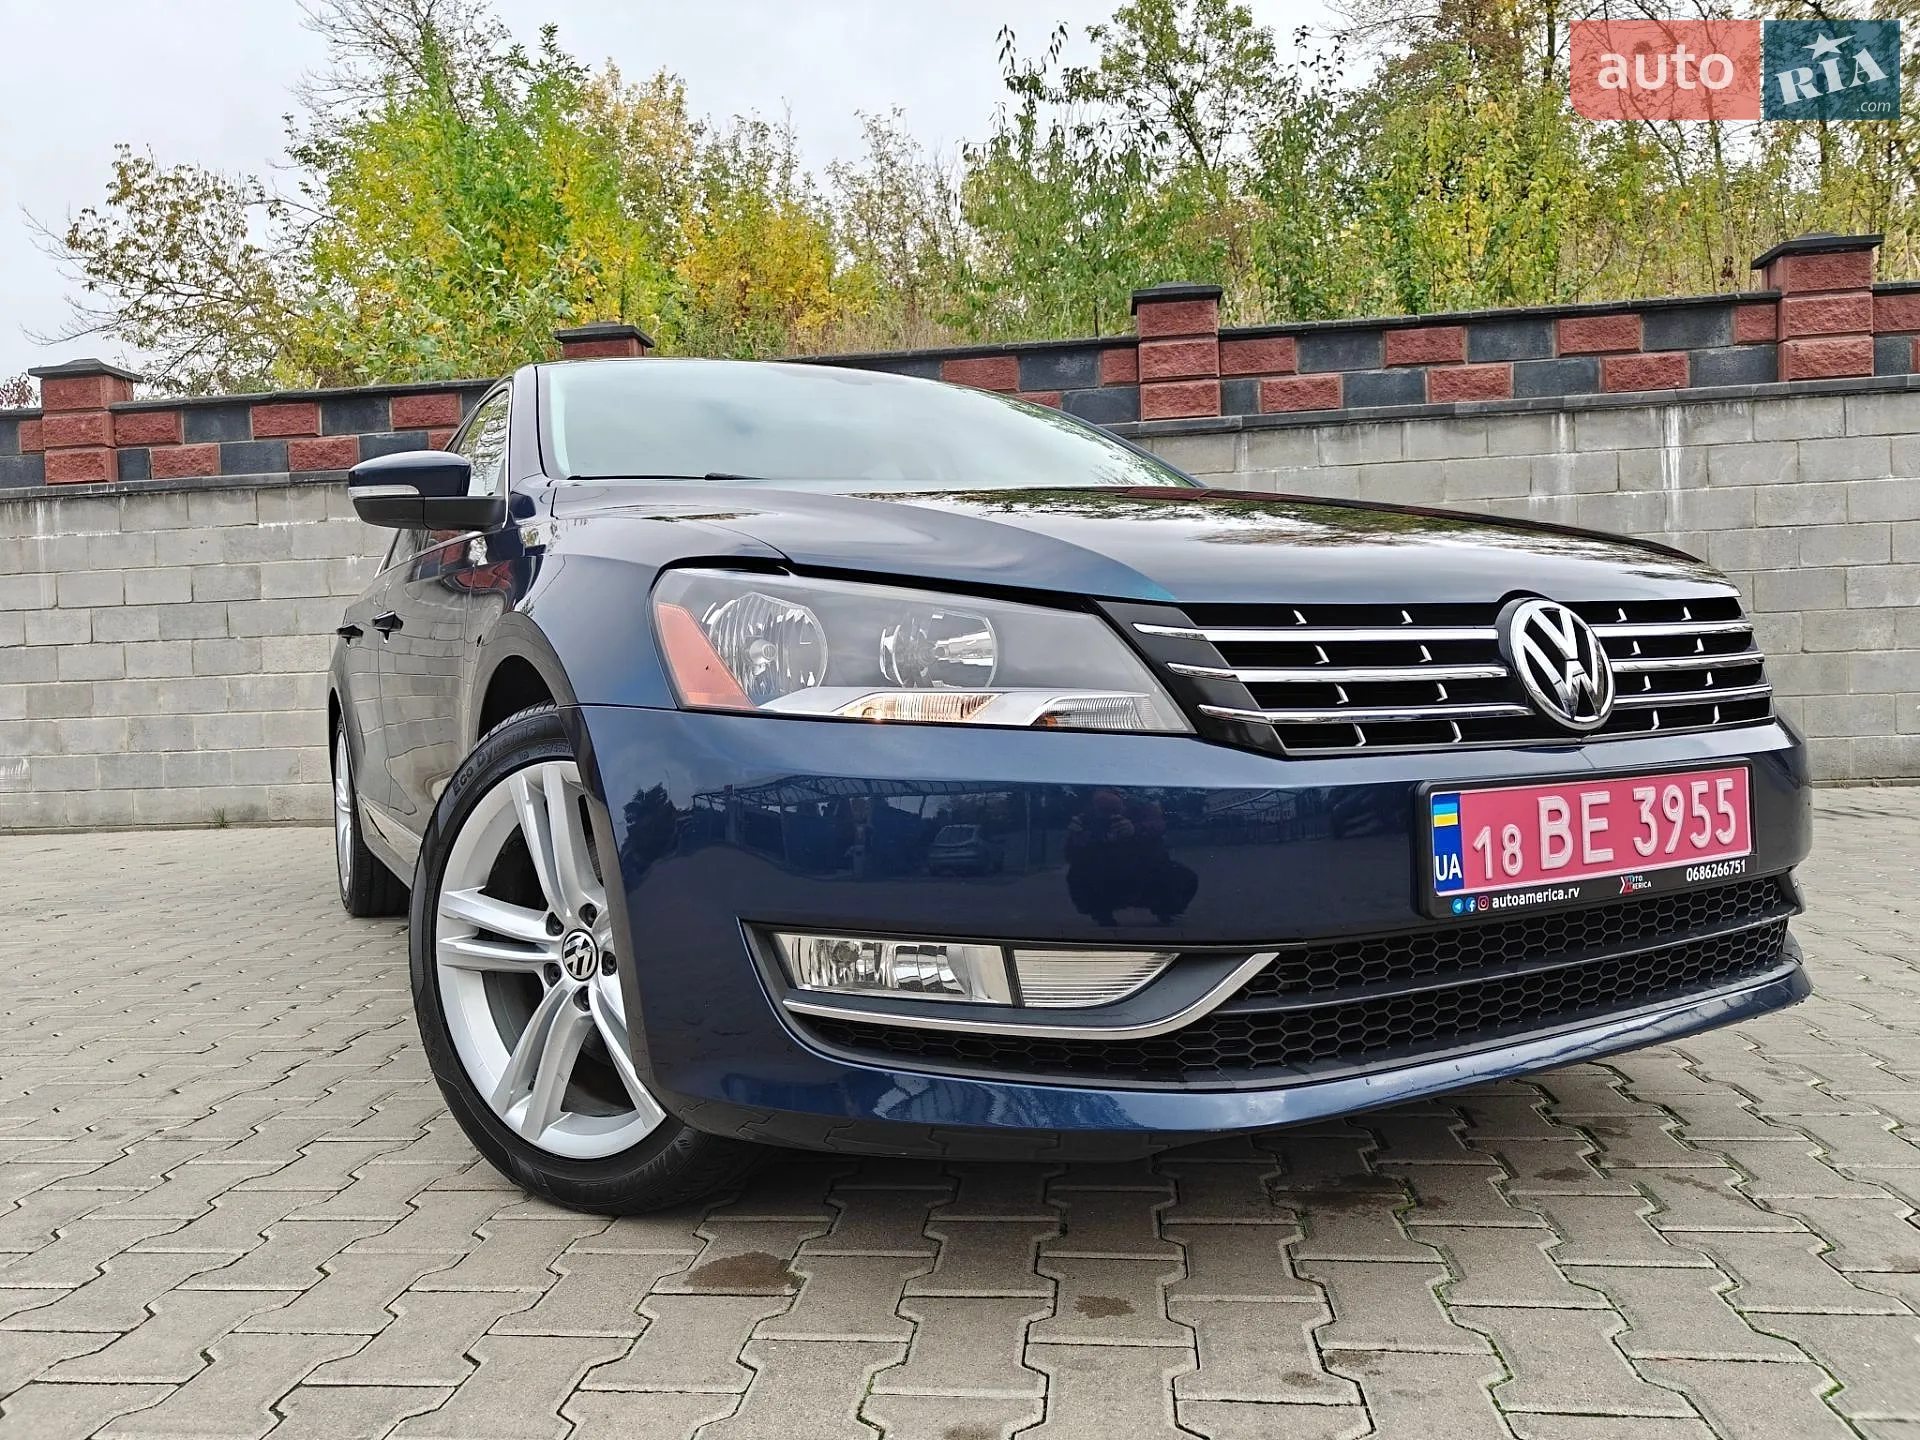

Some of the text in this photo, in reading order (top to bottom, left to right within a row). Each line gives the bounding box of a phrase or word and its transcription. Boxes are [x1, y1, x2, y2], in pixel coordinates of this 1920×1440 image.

[1472, 777, 1737, 880] 18 BE 3955
[1434, 853, 1463, 881] UA
[1686, 858, 1747, 883] 0686266751
[1492, 887, 1580, 909] autoamerica.rv
